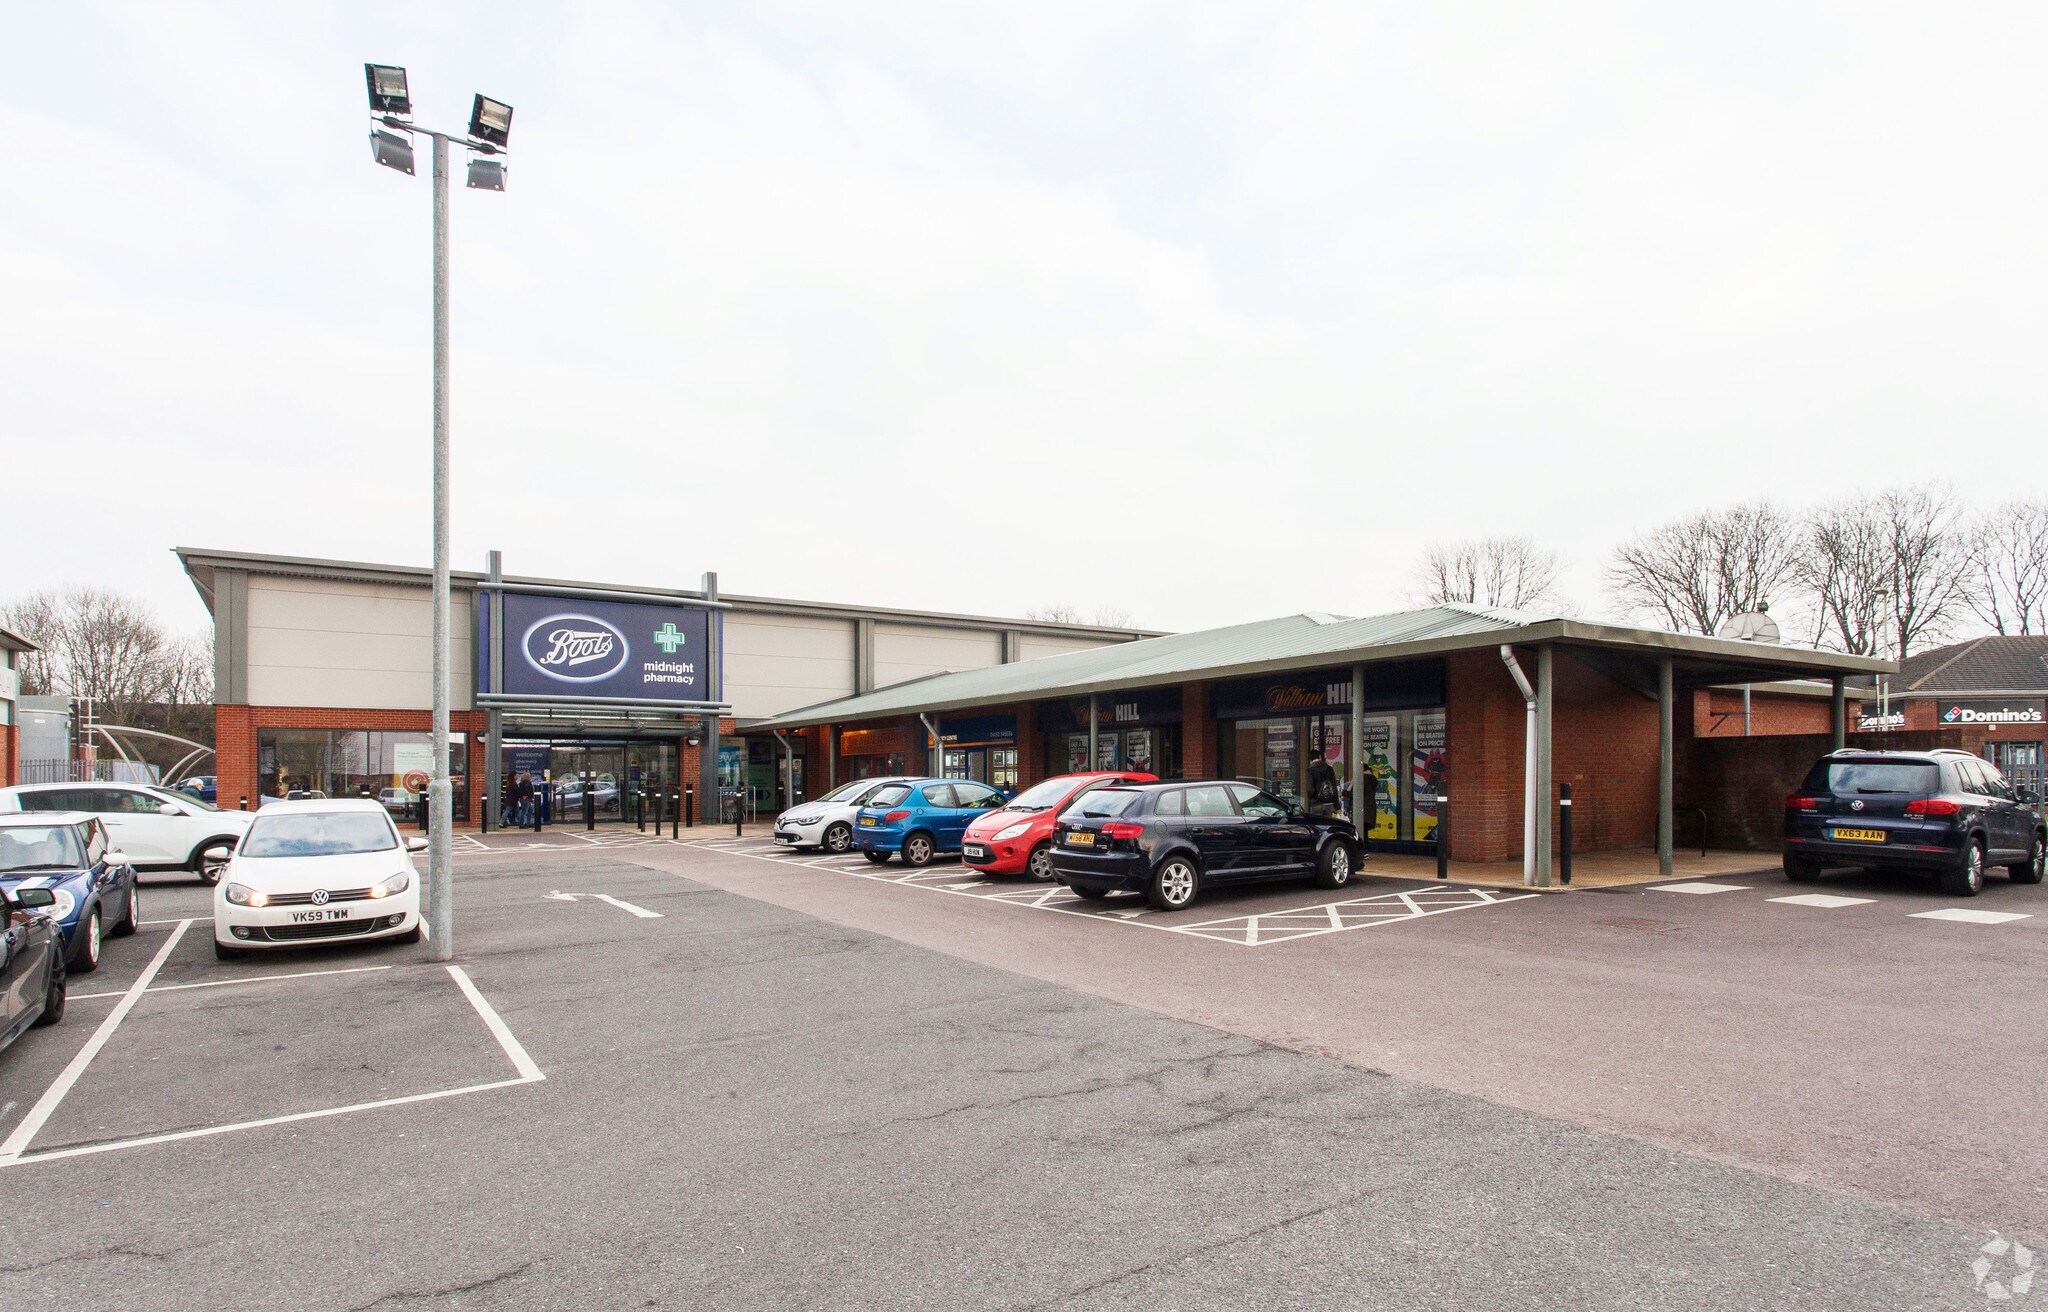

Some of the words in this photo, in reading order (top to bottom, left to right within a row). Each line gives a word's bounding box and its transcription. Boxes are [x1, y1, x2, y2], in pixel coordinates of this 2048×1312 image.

[539, 629, 614, 666] Boots
[644, 661, 694, 675] midnight
[644, 673, 694, 685] pharmacy
[1266, 685, 1324, 711] William
[1327, 683, 1353, 704] HIL
[1116, 703, 1139, 721] HILL
[1961, 708, 2042, 722] Domino's
[1325, 736, 1340, 744] FREE
[1836, 829, 1861, 837] VX63
[1863, 831, 1883, 839] AAN
[293, 912, 323, 922] VK59
[326, 910, 348, 919] TWM
